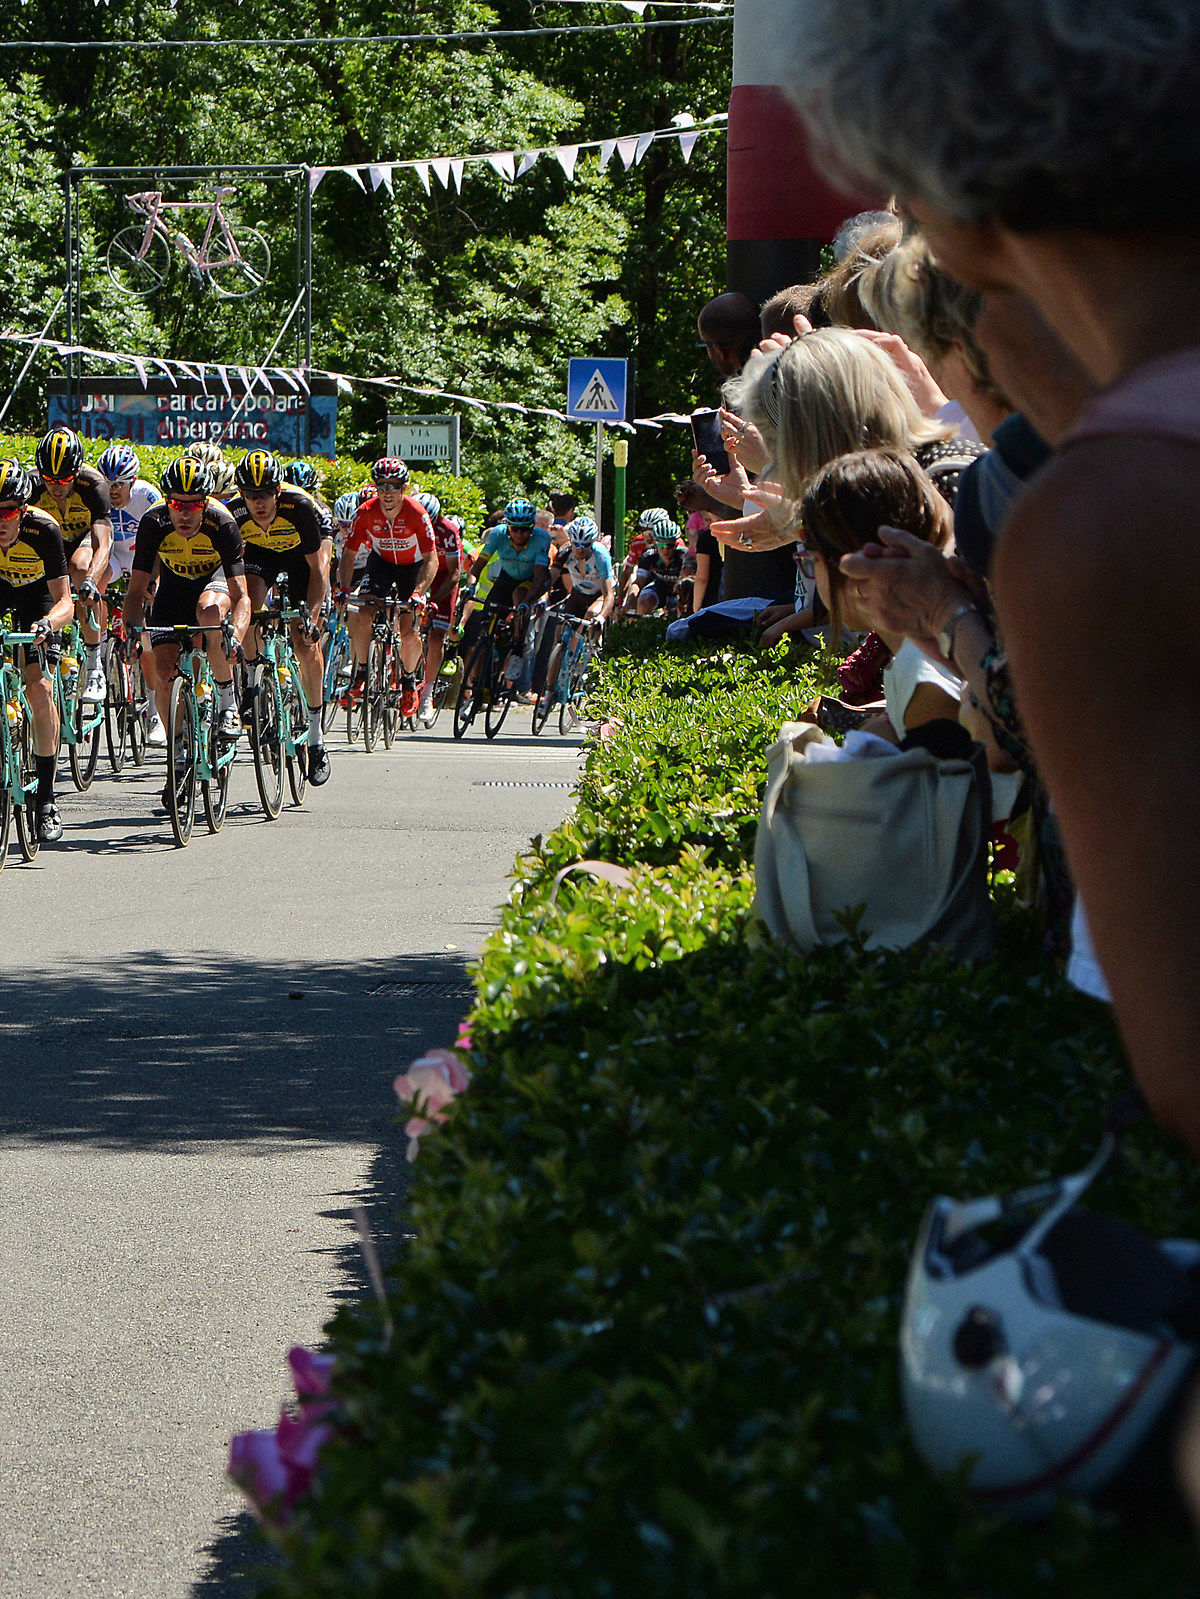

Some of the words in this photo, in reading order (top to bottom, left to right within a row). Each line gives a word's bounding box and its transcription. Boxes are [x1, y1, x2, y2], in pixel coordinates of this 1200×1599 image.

[177, 416, 267, 445] Bergamo
[391, 444, 406, 456] AL
[410, 444, 448, 456] PORTO
